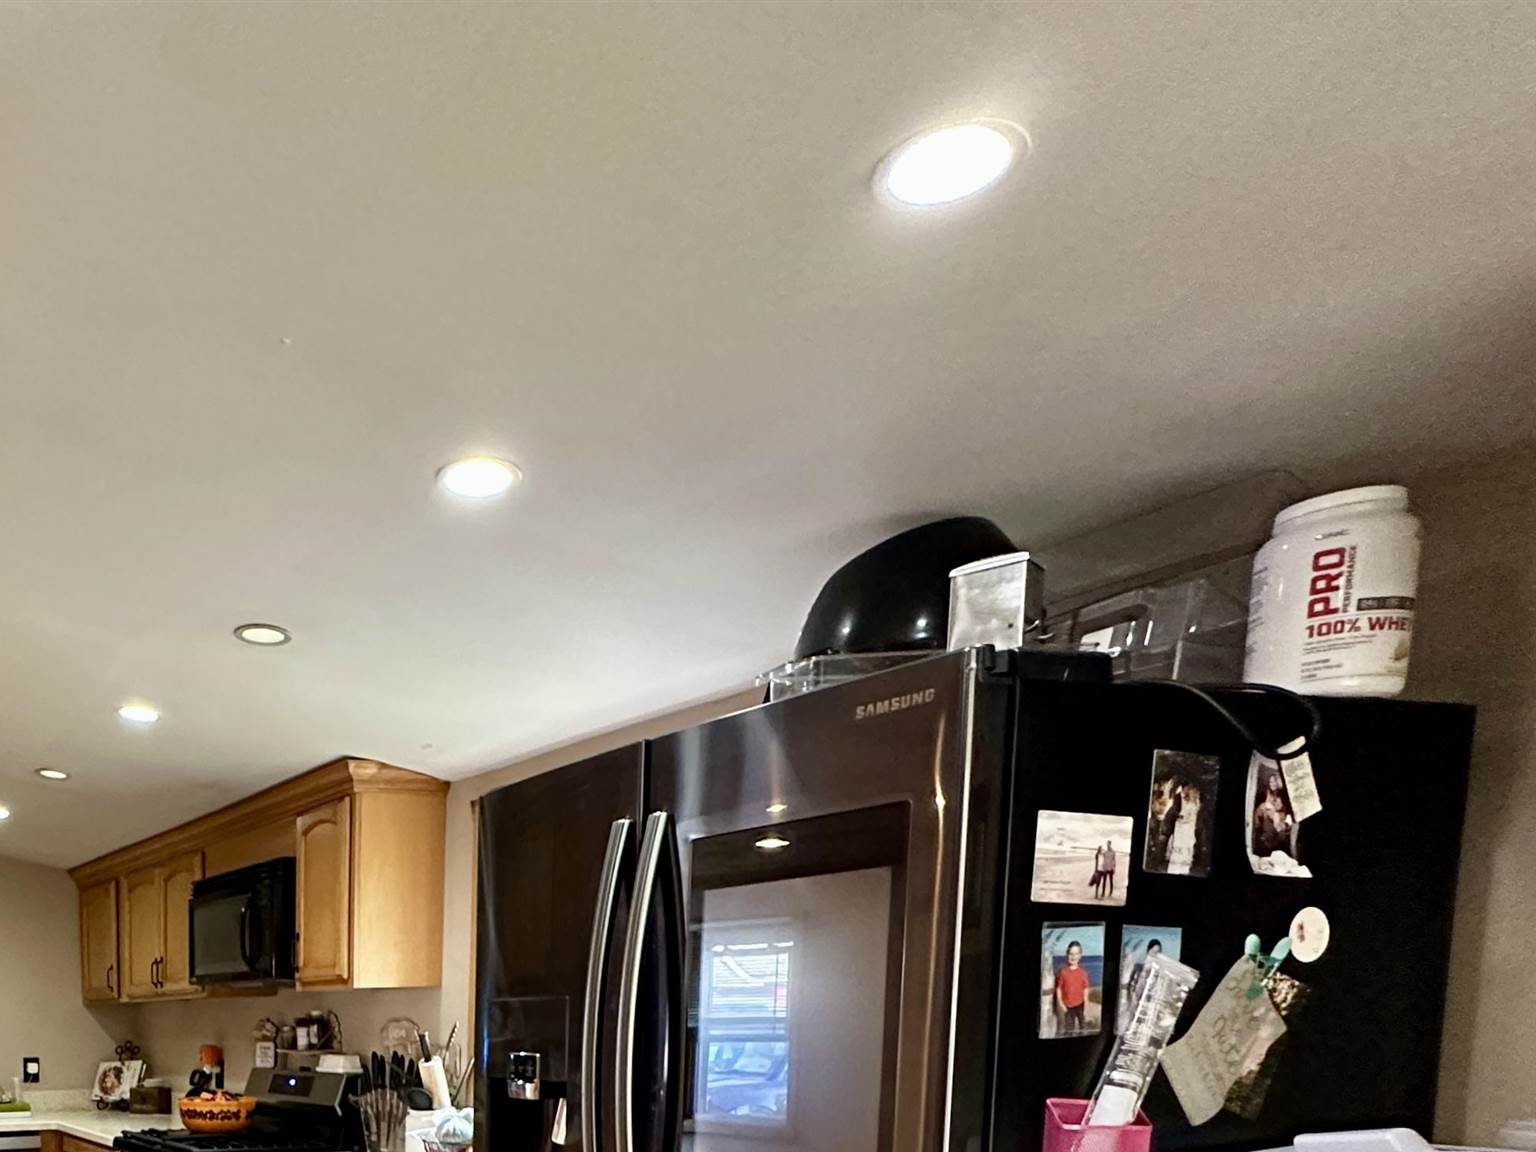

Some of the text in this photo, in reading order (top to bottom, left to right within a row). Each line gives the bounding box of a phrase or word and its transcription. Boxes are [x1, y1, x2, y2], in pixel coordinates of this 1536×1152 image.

[1306, 546, 1347, 619] PRO
[1341, 545, 1358, 614] PERFORMANCE
[1305, 617, 1362, 639] 100%
[855, 688, 936, 719] SAMSUNG
